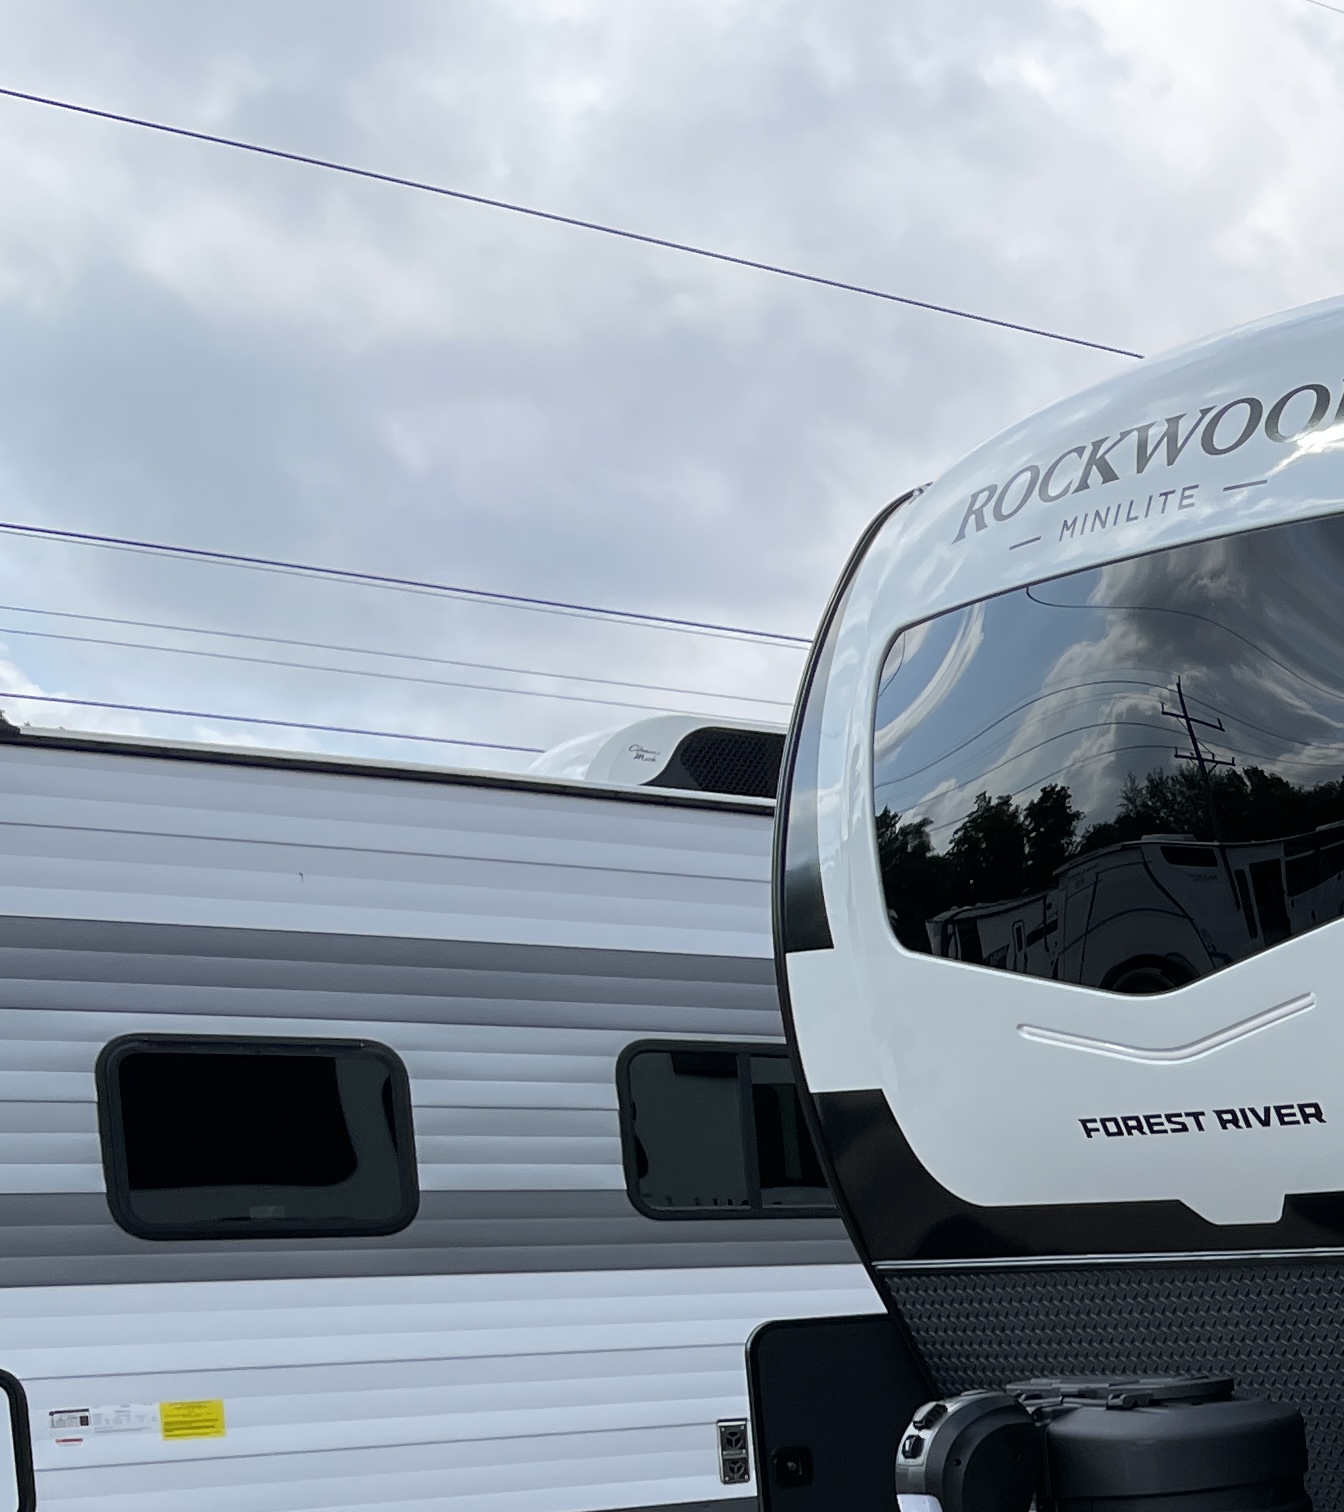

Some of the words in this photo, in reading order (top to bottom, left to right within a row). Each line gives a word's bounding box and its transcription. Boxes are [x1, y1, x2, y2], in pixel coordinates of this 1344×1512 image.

[1058, 484, 1199, 543] MINILITE
[1078, 1110, 1206, 1139] FOREST
[1212, 1102, 1327, 1131] RIVER
